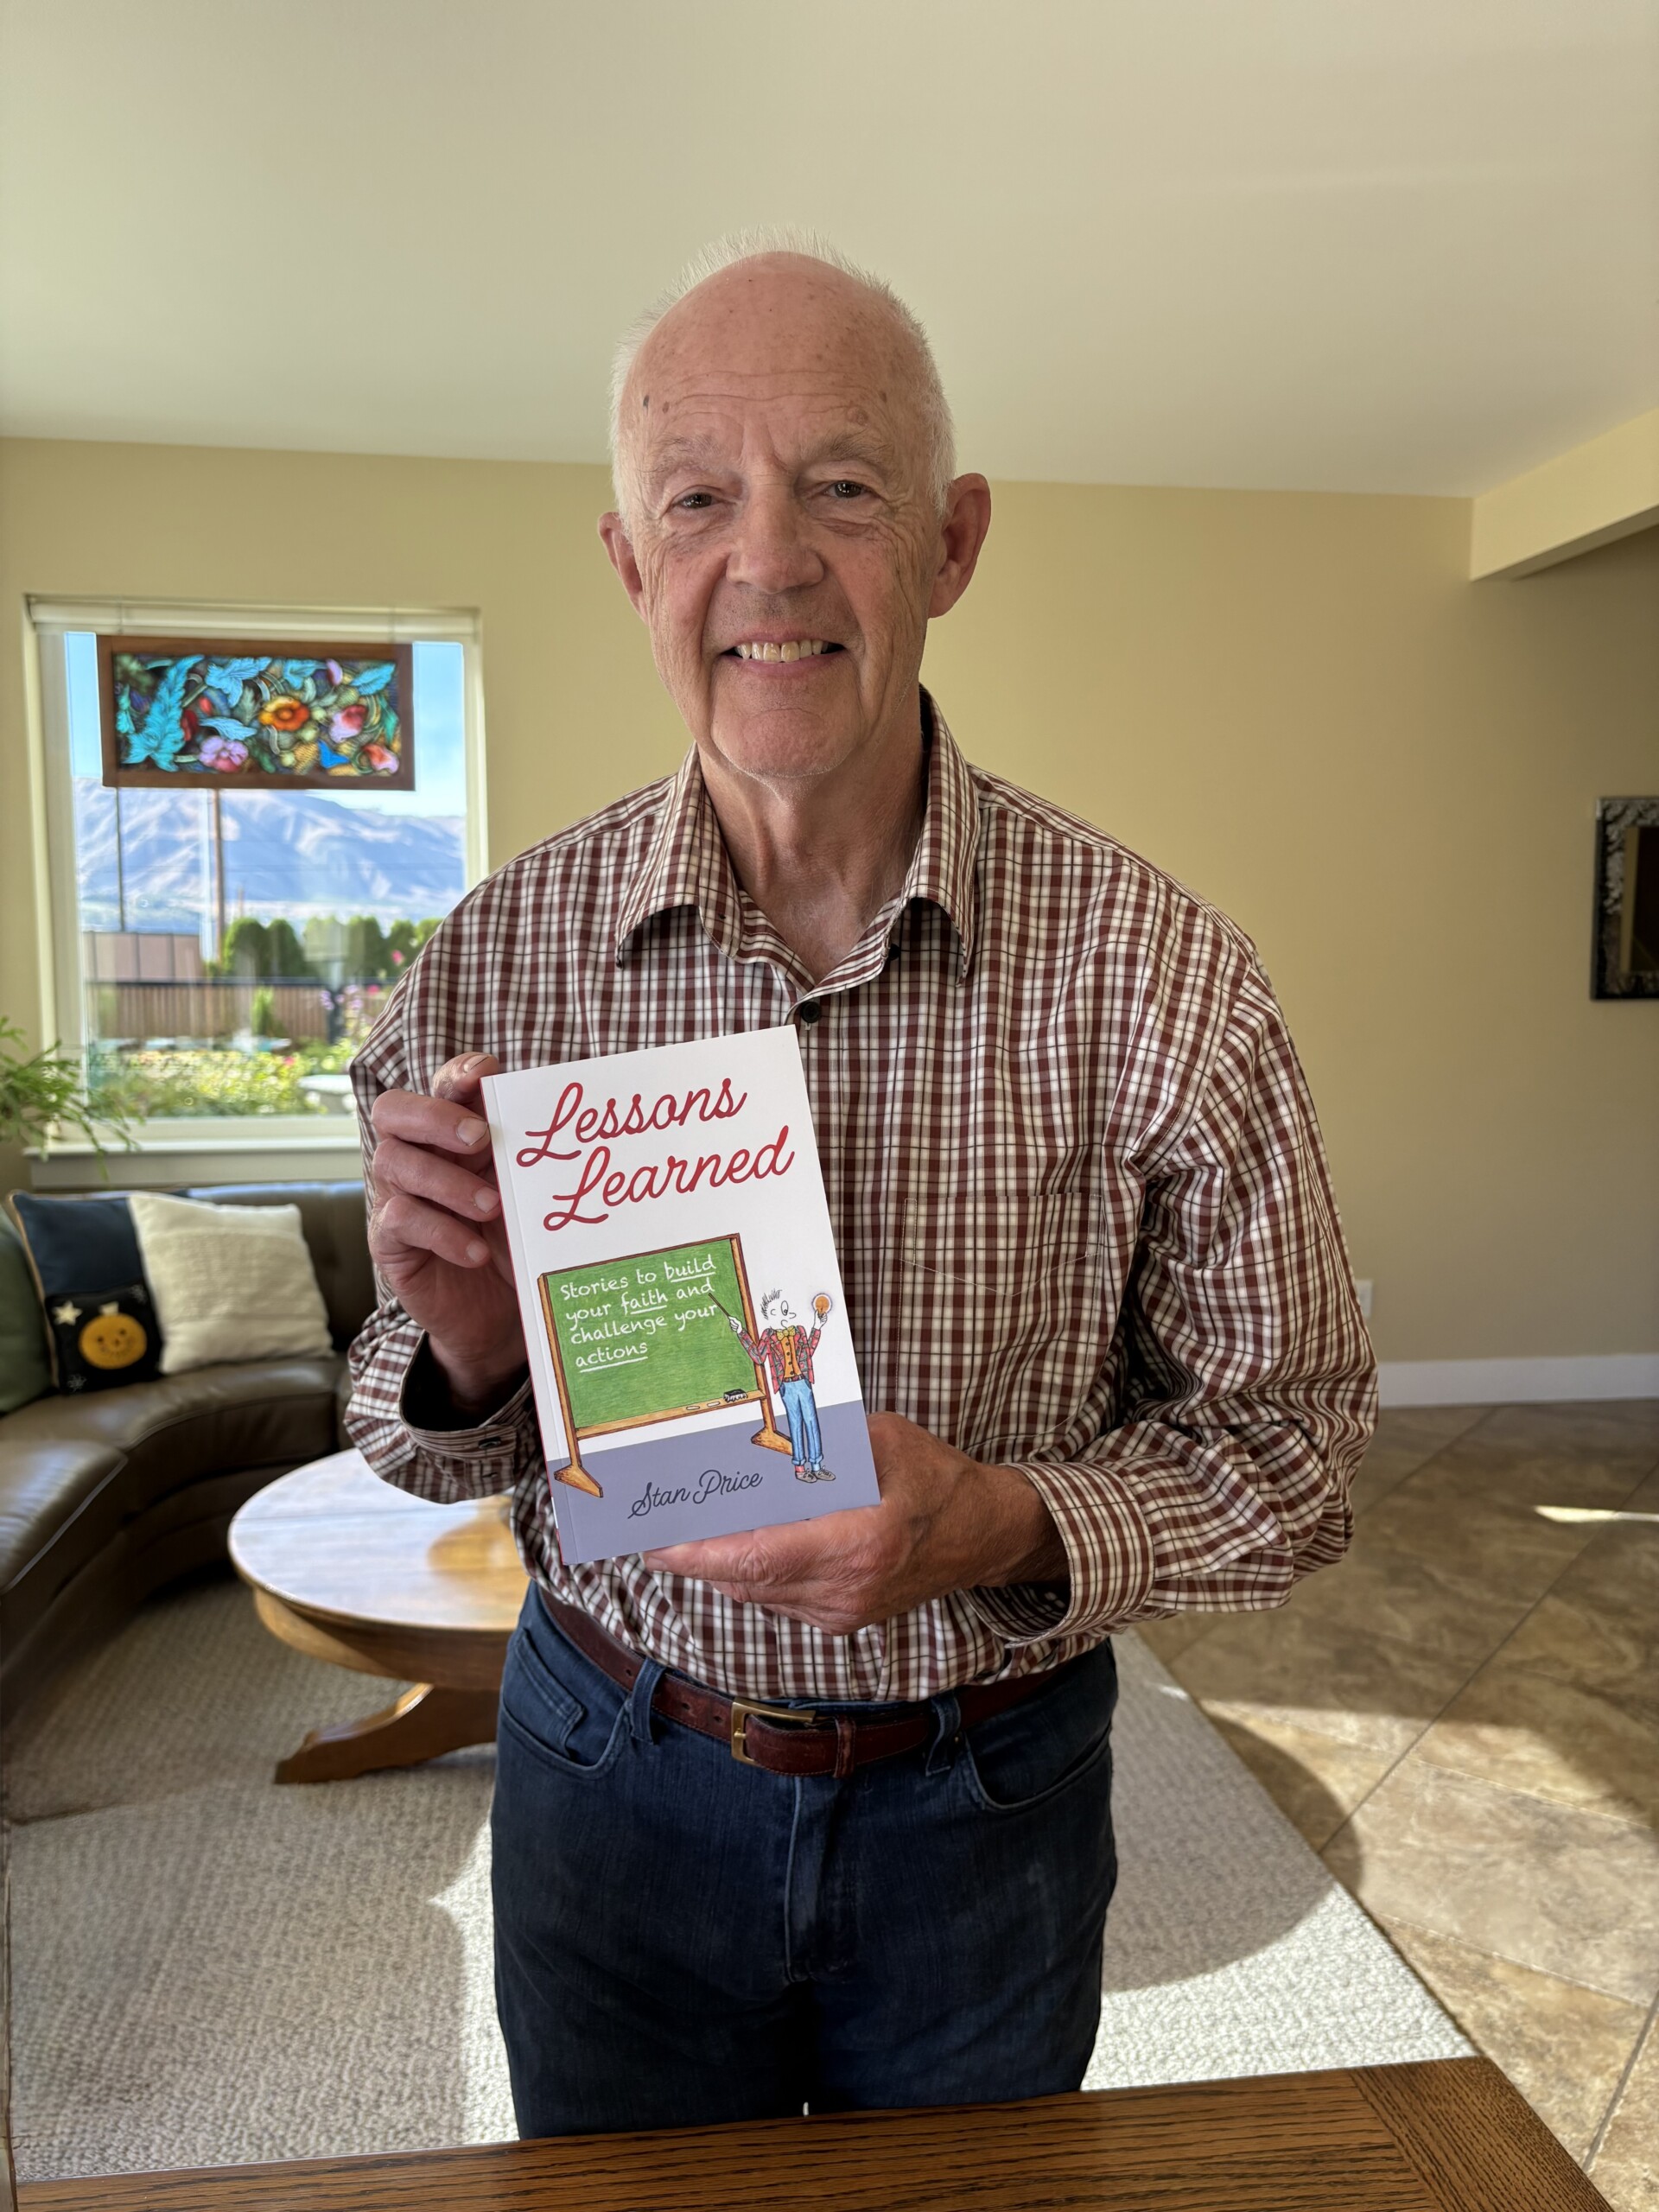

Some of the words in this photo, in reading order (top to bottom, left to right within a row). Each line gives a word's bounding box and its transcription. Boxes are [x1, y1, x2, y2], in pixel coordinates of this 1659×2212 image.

[516, 1077, 747, 1167] Lessons
[543, 1125, 795, 1231] Learned
[560, 1276, 629, 1300] Stories
[636, 1268, 657, 1284] to
[664, 1254, 716, 1281] build
[566, 1303, 612, 1331] your
[621, 1290, 668, 1314] faith
[677, 1277, 715, 1300] and
[570, 1315, 667, 1344] challenge
[675, 1304, 718, 1332] your
[575, 1342, 648, 1368] actions
[627, 1481, 691, 1519] Stan
[692, 1469, 763, 1504] Price
